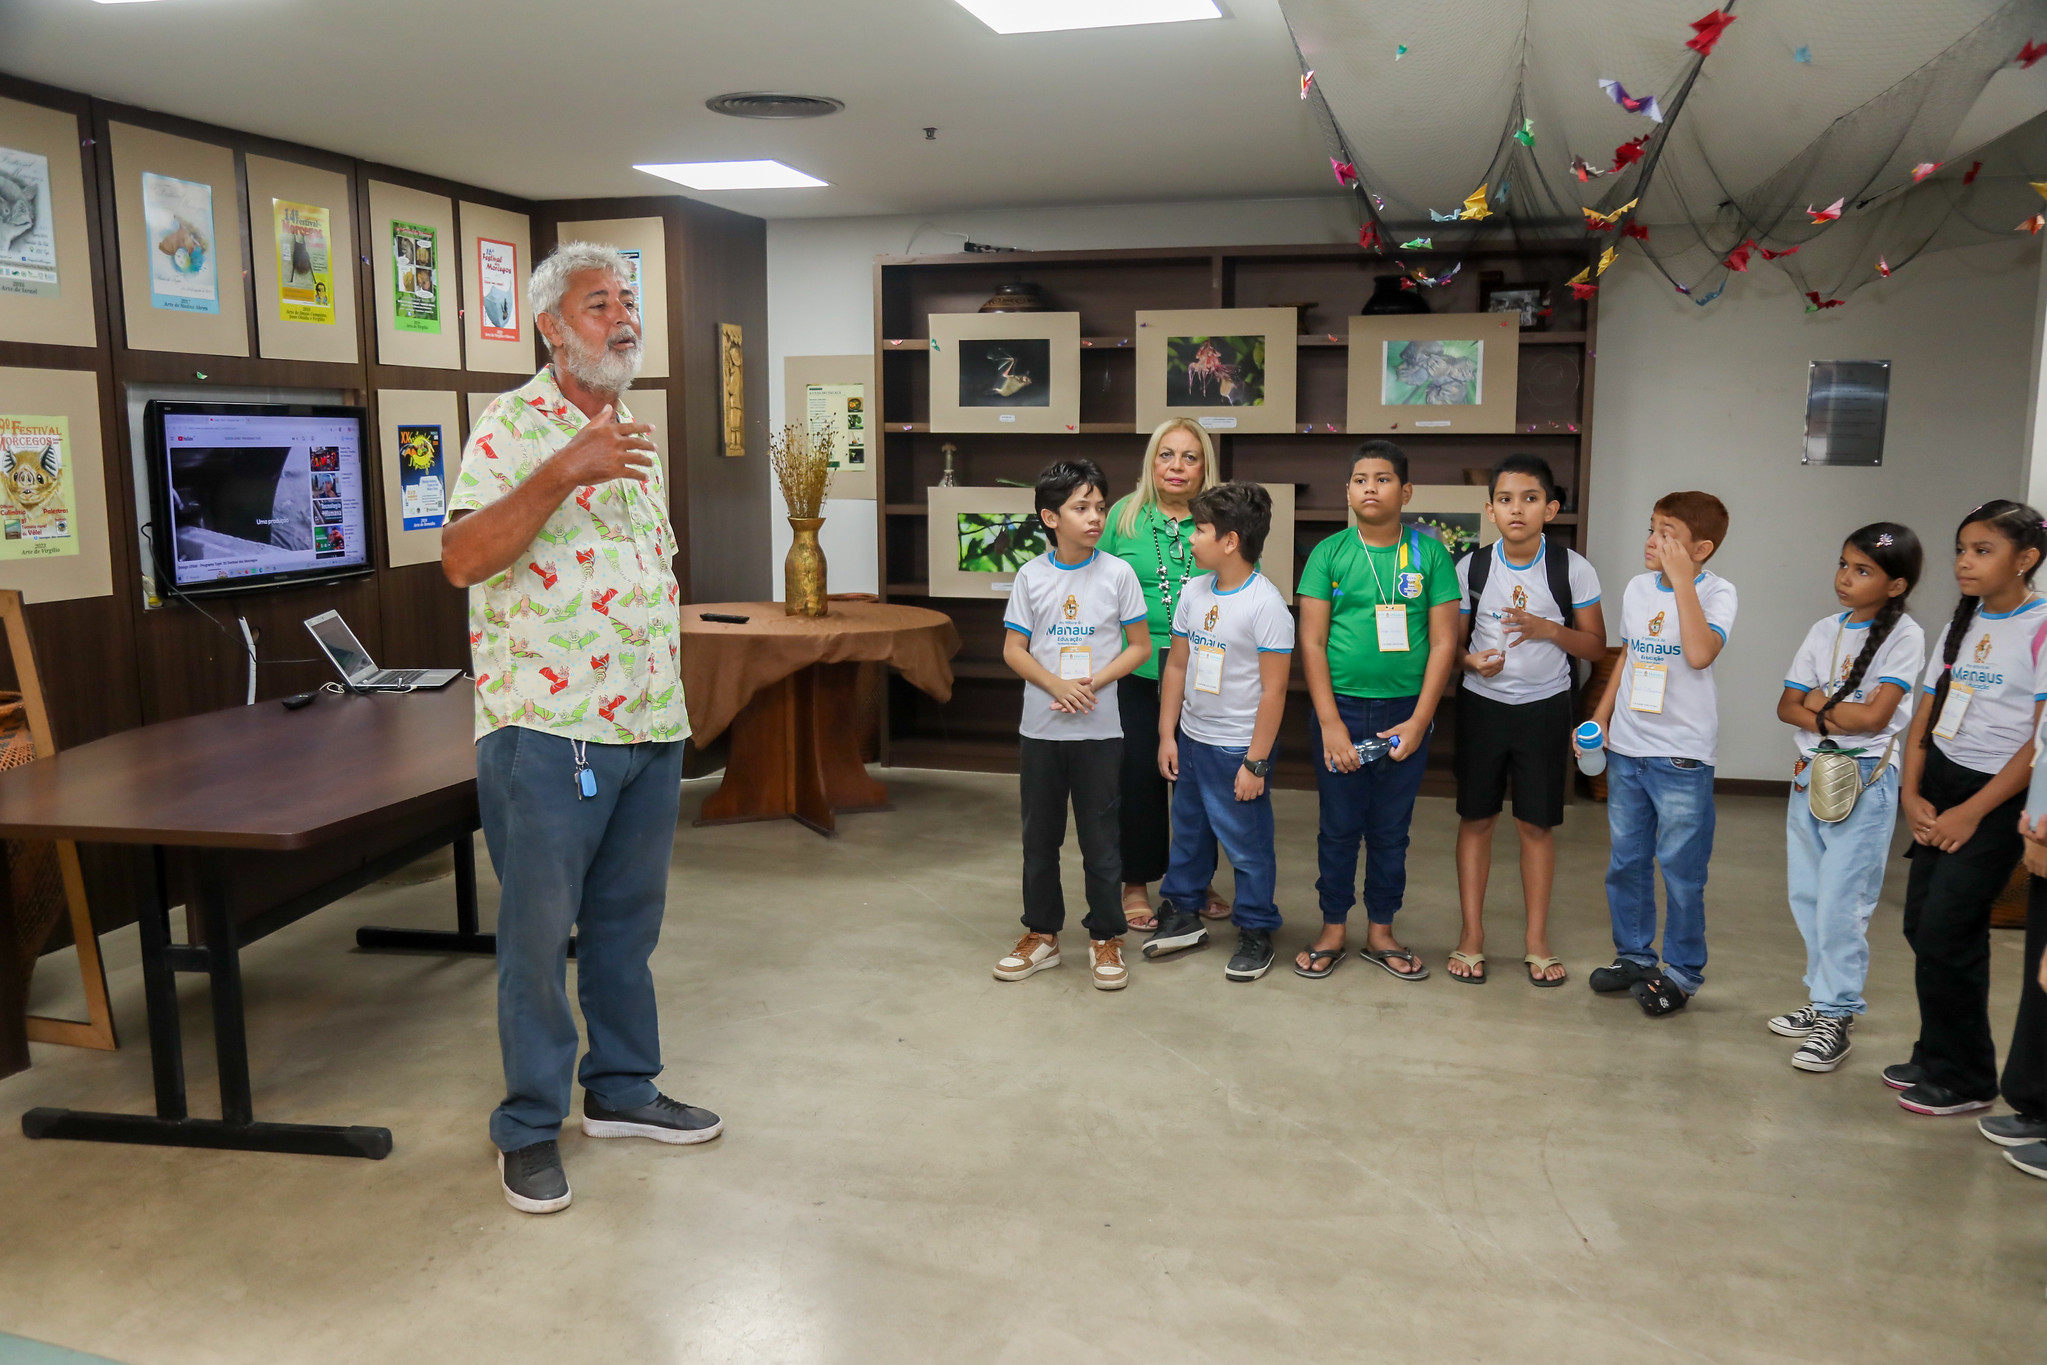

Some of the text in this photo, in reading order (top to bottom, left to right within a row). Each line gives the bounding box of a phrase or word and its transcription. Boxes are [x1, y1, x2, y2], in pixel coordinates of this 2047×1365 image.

[282, 219, 323, 239] Morcegos
[483, 253, 502, 263] Festival
[12, 420, 62, 435] FESTIVAL
[1046, 624, 1095, 636] Manaus
[1631, 638, 1681, 655] Manaus
[1951, 667, 2003, 685] Manaus
